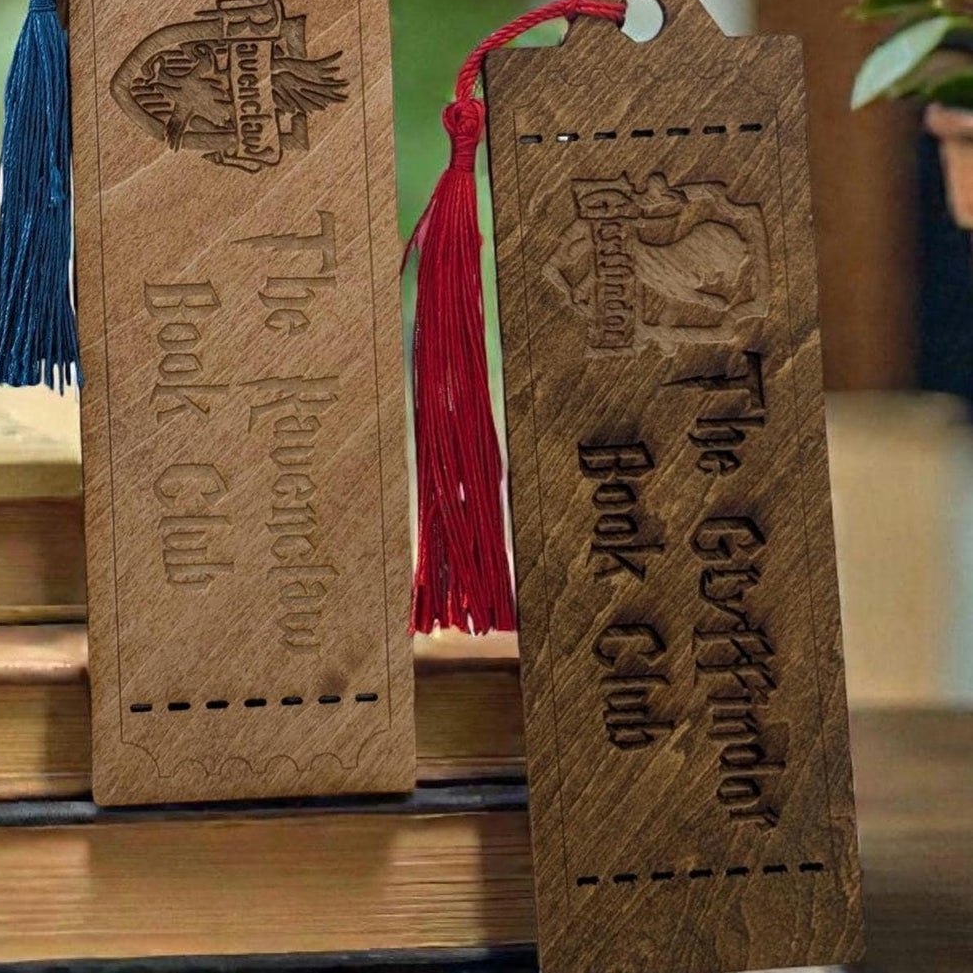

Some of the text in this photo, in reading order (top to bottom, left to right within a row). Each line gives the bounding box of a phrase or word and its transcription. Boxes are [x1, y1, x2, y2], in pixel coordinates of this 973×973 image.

[205, 0, 276, 157] Ravenclaw
[577, 187, 637, 341] Gryffindor
[143, 279, 235, 593] Book Club
[230, 209, 341, 656] The Ravenclaw
[660, 349, 784, 829] The Gryffindor
[577, 440, 676, 752] Book Club
